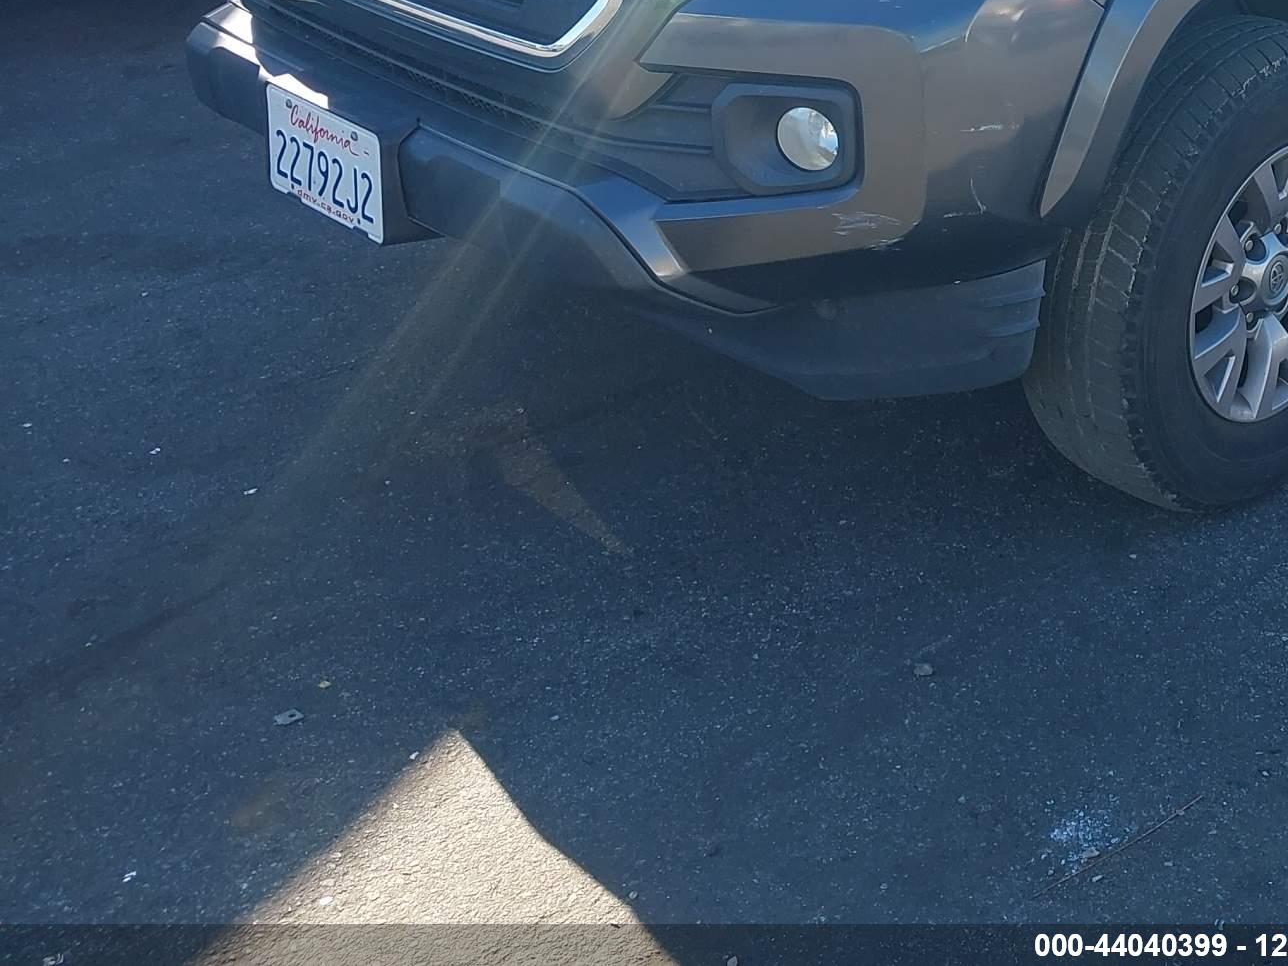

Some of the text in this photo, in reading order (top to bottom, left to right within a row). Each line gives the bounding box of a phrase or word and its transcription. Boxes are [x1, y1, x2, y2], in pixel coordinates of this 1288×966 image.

[290, 104, 360, 157] California
[276, 129, 375, 224] 22792J2
[297, 189, 354, 224] dmv.ca.gov
